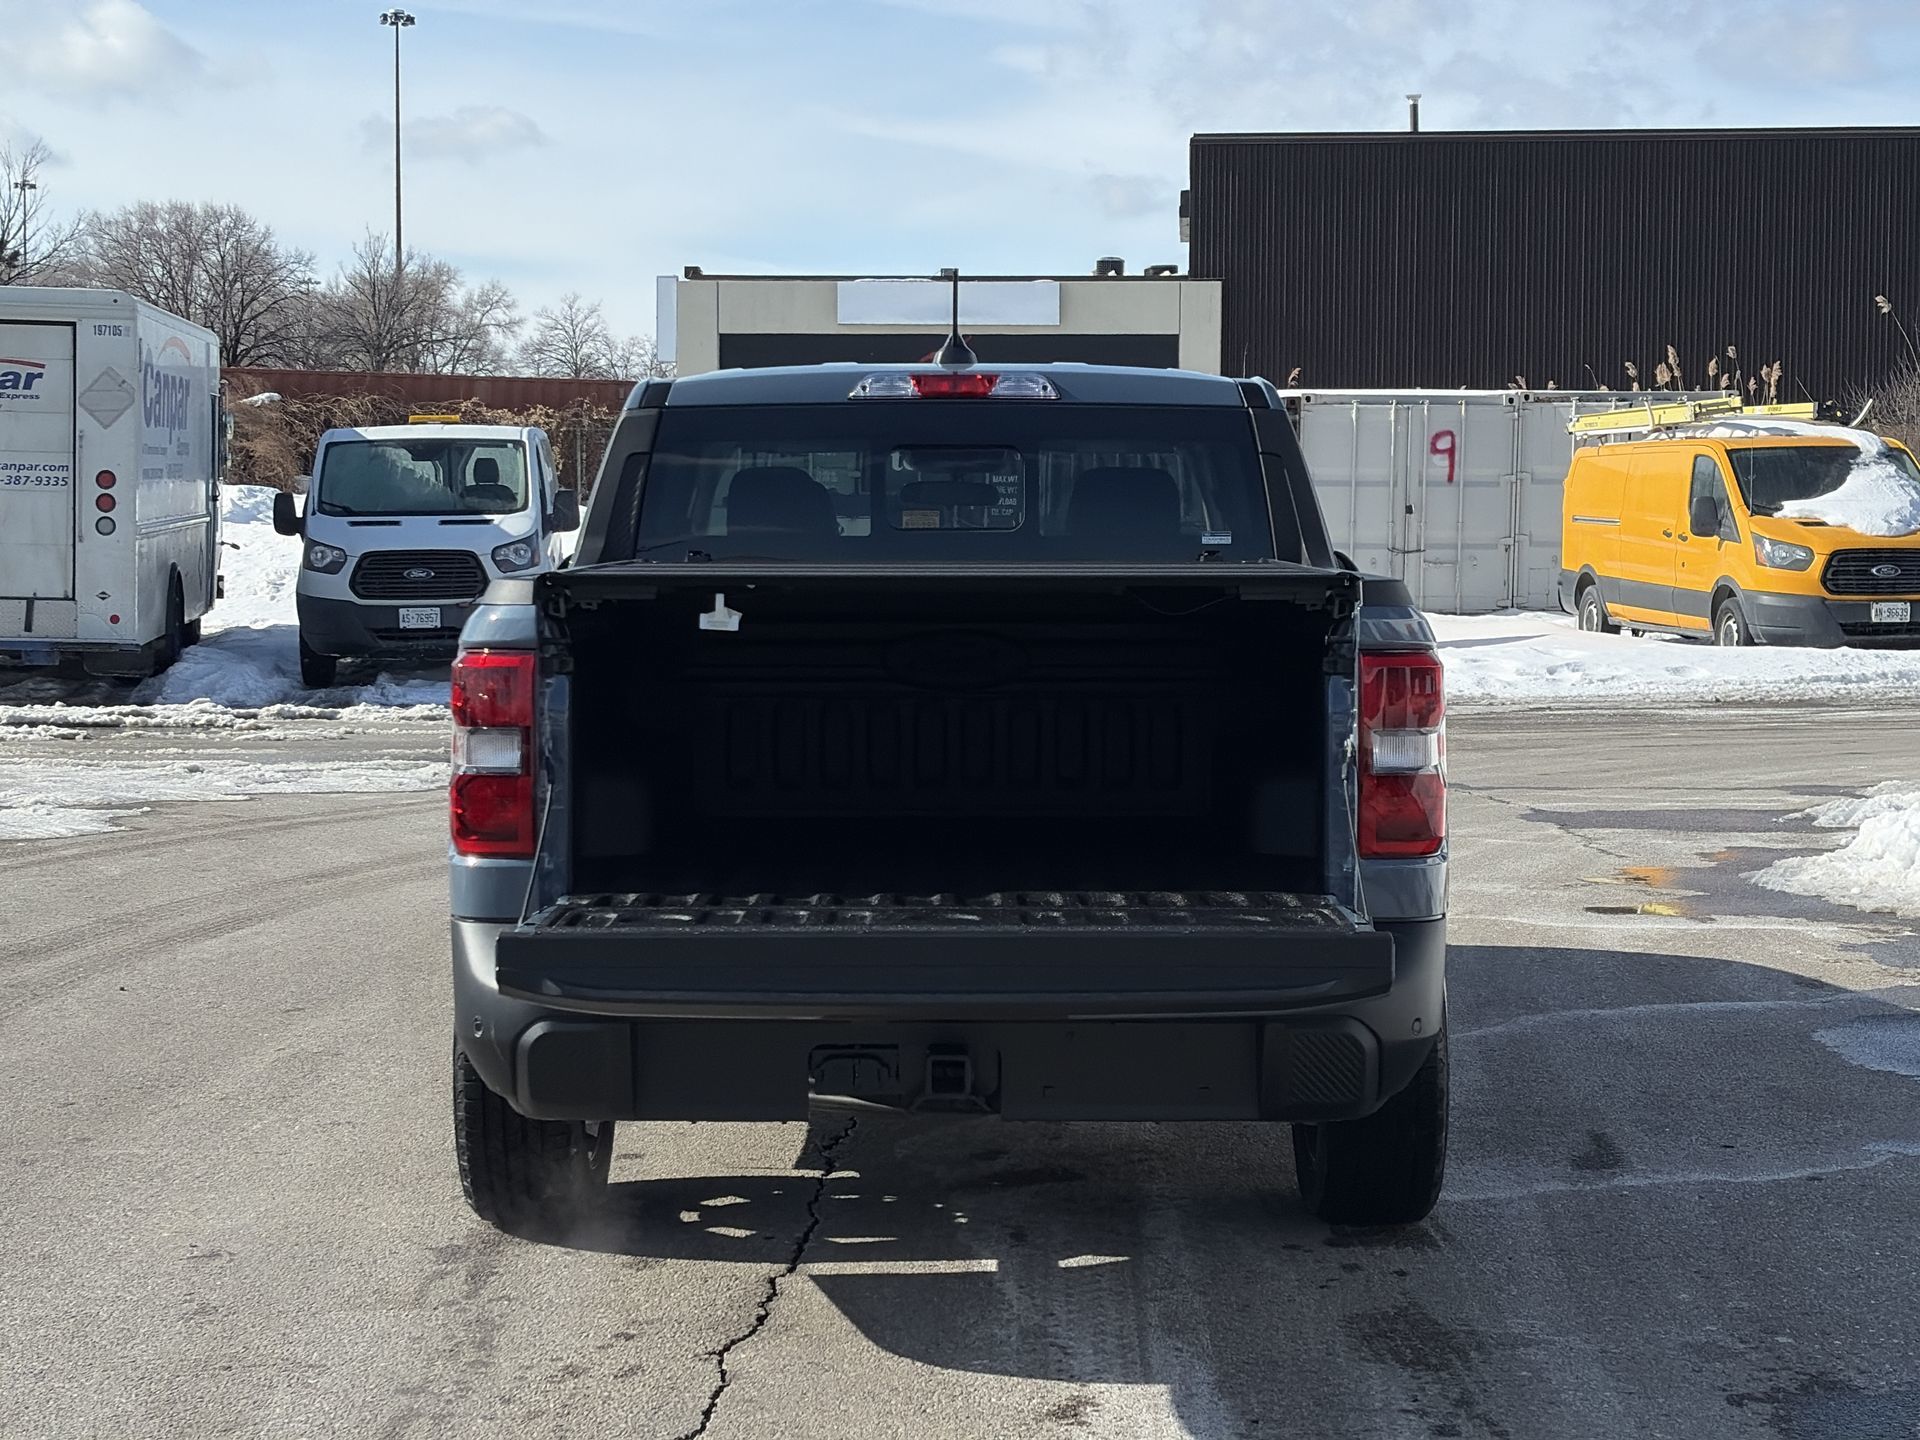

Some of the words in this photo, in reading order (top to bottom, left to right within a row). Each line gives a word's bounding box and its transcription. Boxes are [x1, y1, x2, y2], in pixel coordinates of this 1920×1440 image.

[93, 325, 123, 337] 197105
[0, 392, 40, 401] Express
[143, 344, 191, 446] Canpar
[1430, 429, 1457, 483] 9
[0, 462, 69, 473] anpar.com
